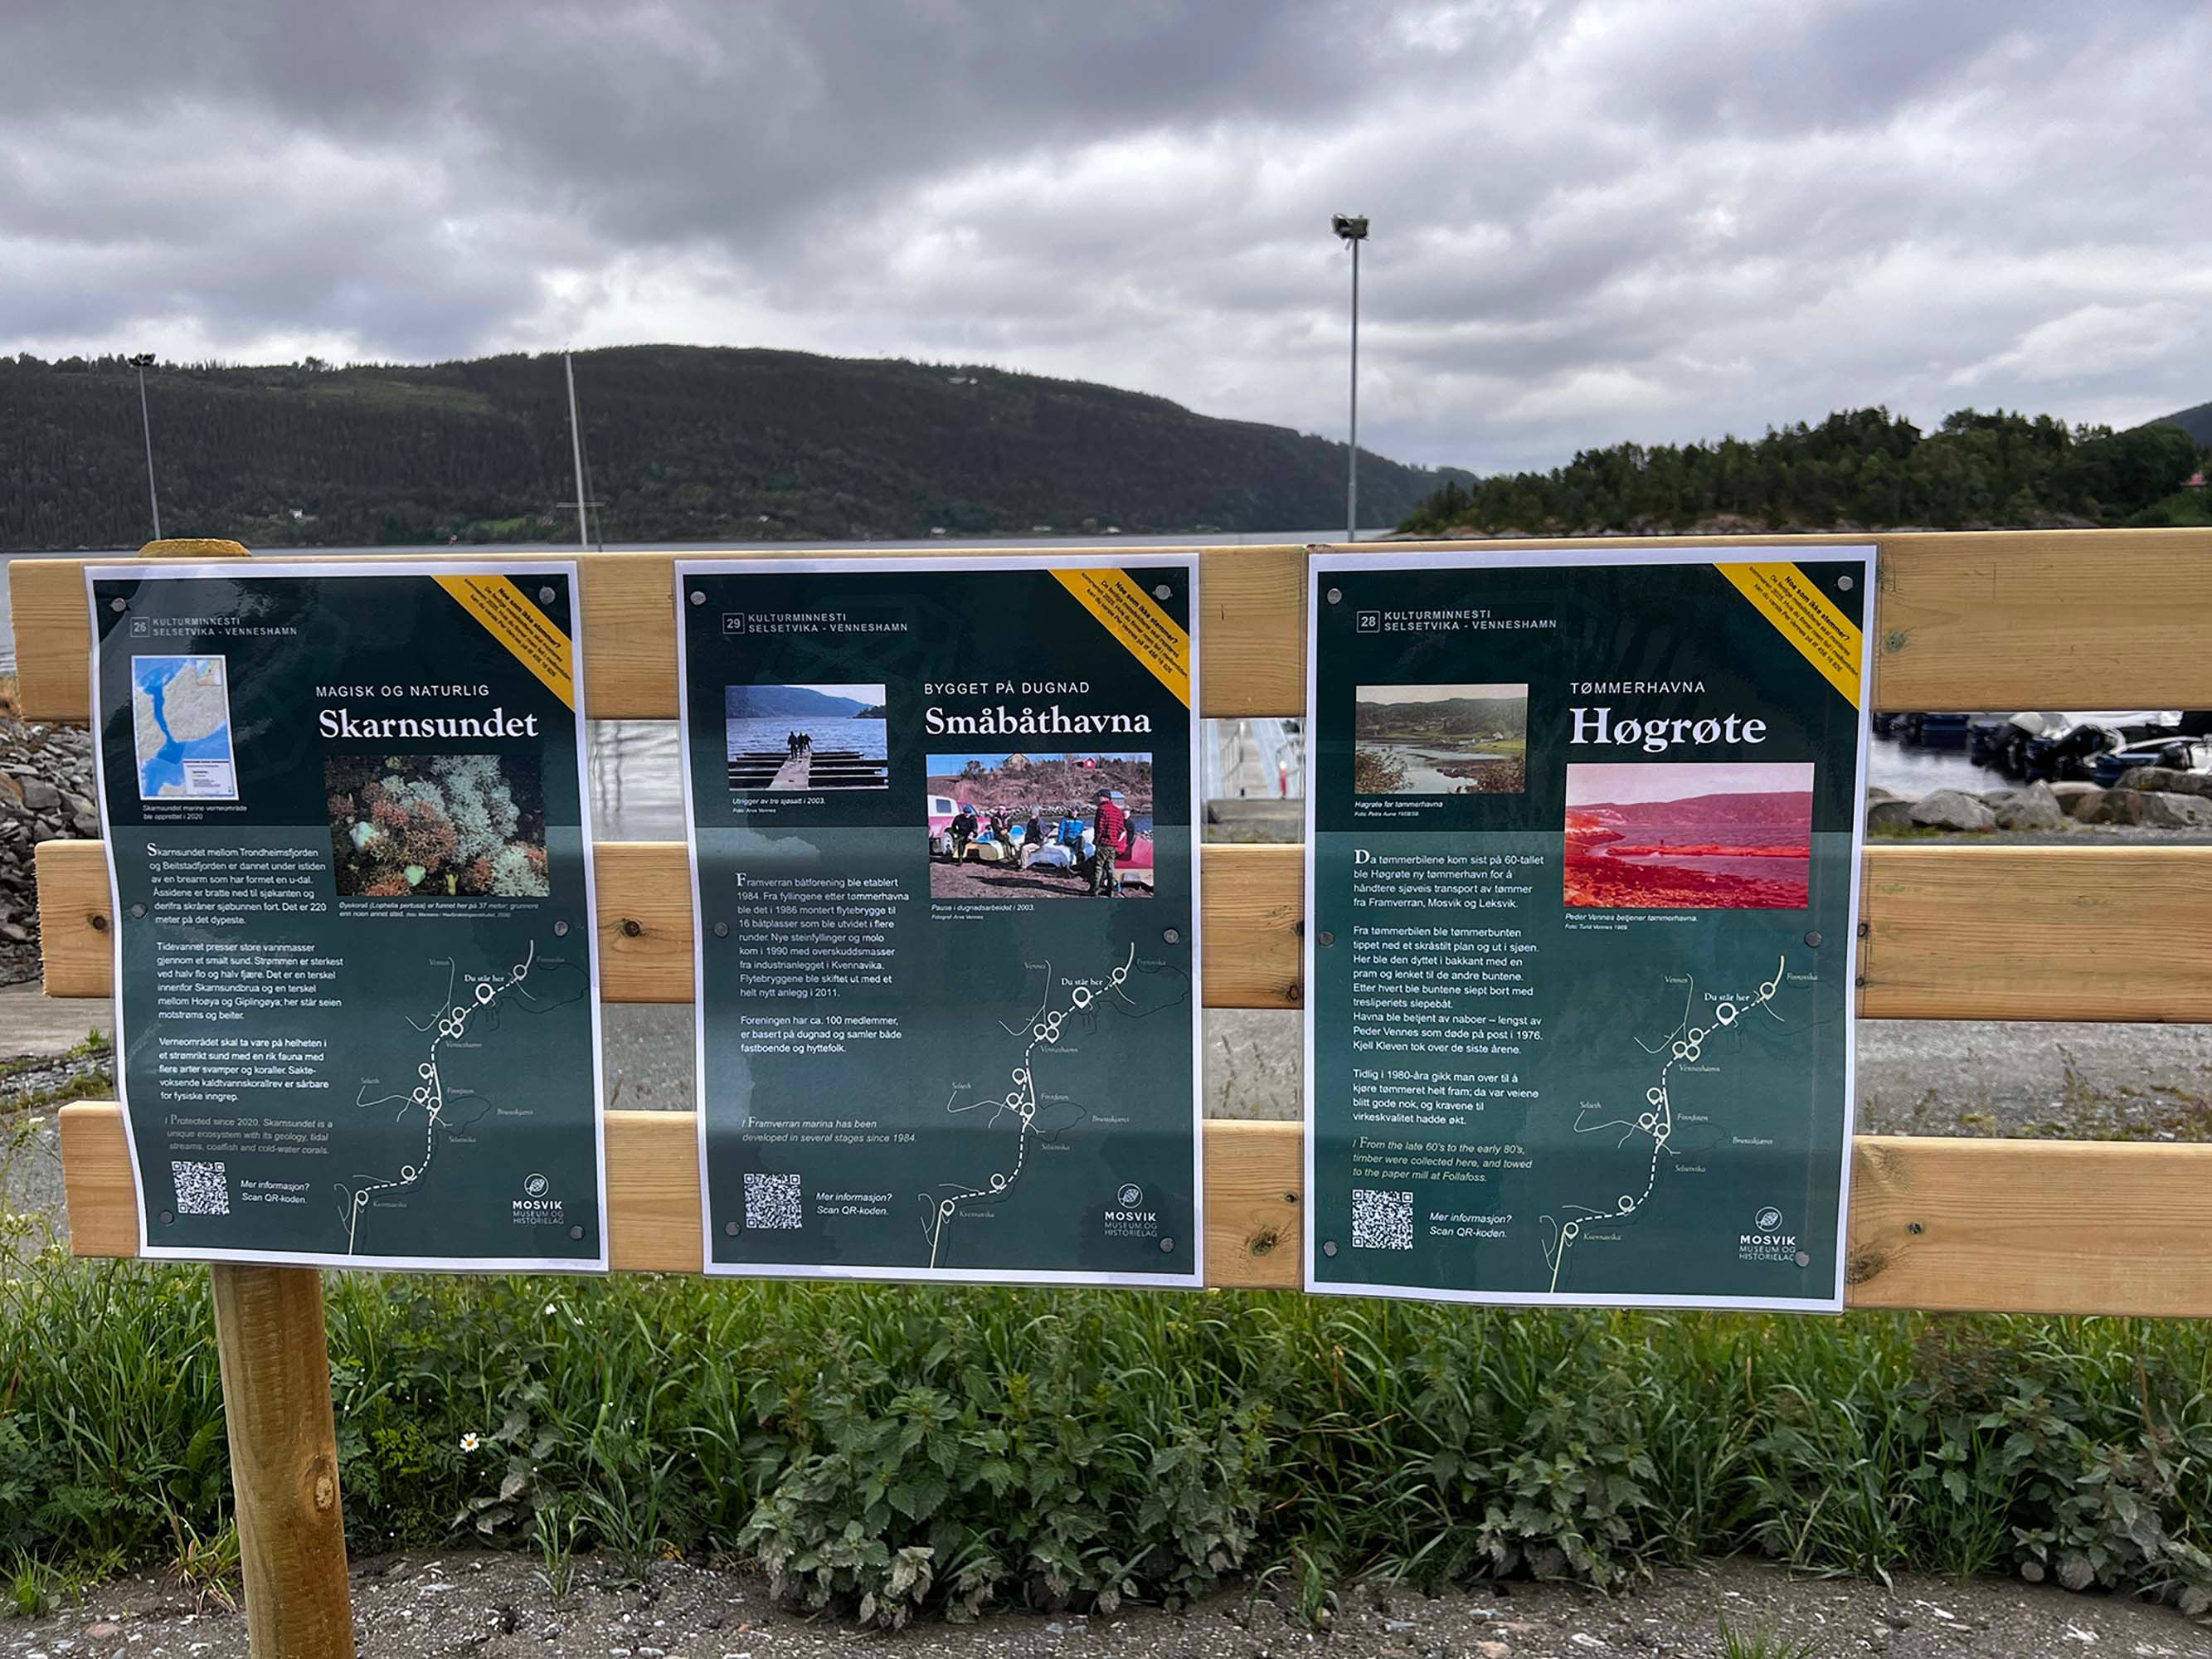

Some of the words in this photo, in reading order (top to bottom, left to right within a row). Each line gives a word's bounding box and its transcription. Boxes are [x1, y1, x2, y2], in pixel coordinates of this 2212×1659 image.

[1115, 581, 1127, 595] Noe
[1127, 593, 1139, 607] som
[1139, 604, 1151, 618] ikke
[1785, 576, 1798, 590] Noe
[1797, 589, 1810, 603] som
[1809, 599, 1822, 614] ikke
[498, 588, 510, 601] Noe
[510, 599, 522, 612] som
[521, 609, 534, 623] ikke
[748, 613, 846, 622] KULTURMINNESTI
[1384, 610, 1490, 620] KULTURMINNESTI
[153, 617, 240, 625] KULTURMINNESTI
[726, 618, 740, 628] 29
[1361, 616, 1375, 626] 28
[1384, 621, 1459, 631] SELSETVIKA
[1472, 619, 1556, 629] VENNESHAMN
[133, 622, 146, 632] 26
[153, 627, 214, 635] SELSETVIKA
[224, 627, 296, 635] VENNESHAMN
[748, 624, 818, 632] SELSETVIKA
[829, 623, 907, 631] VENNESHAMN
[316, 685, 374, 697] MAGISK
[380, 685, 403, 696] OG
[410, 684, 489, 696] NATURLIG
[924, 683, 988, 694] BYGGET
[996, 682, 1014, 693] PÅ
[1022, 681, 1089, 693] DUGNAD
[1570, 681, 1705, 694] TØMMERHAVNA
[319, 707, 538, 737] Skarnsundet
[925, 705, 1151, 734] Småbåthavna
[1569, 707, 1766, 752] Høgrøte
[147, 843, 205, 856] Skarnsundet
[207, 848, 238, 856] mellom
[238, 847, 318, 858] Trondheimsfjorden
[1354, 849, 1376, 864] Da
[1378, 855, 1444, 864] tømmerbilene
[1447, 855, 1467, 864] kom
[1470, 855, 1487, 864] sist
[1489, 855, 1501, 865] på
[1504, 855, 1544, 864] 60-tallet
[149, 862, 160, 871] og
[162, 861, 226, 871] Beitstadfjorden
[270, 862, 295, 870] under
[297, 862, 325, 870] istiden
[245, 875, 274, 883] formet
[288, 875, 312, 883] u-dal.
[1353, 869, 1368, 878] ble
[1370, 869, 1410, 880] Høgrøte
[1413, 871, 1424, 880] ny
[1427, 870, 1487, 878] tømmerhavn
[1490, 869, 1503, 878] for
[1505, 869, 1512, 878] å
[1353, 883, 1395, 892] håndtere
[1398, 884, 1431, 894] sjøveis
[1434, 884, 1477, 894] transport
[1494, 885, 1532, 893] tømmer
[1353, 897, 1366, 906] fra
[1368, 897, 1425, 907] Framverran,
[1427, 898, 1461, 907] Mosvik
[1463, 900, 1476, 909] og
[1478, 898, 1517, 907] Leksvik.
[477, 975, 490, 983] står
[1074, 978, 1088, 987] står
[740, 1016, 790, 1026] Foreningen
[792, 1016, 807, 1024] har
[825, 1016, 842, 1024] 100
[844, 1016, 898, 1025] medlemmer,
[752, 1030, 781, 1038] basert
[783, 1029, 794, 1039] på
[796, 1030, 830, 1040] dugnad
[832, 1031, 844, 1040] og
[846, 1029, 877, 1038] samler
[879, 1030, 902, 1038] både
[740, 1043, 790, 1052] fastboende
[792, 1045, 804, 1054] og
[806, 1043, 845, 1054] hyttefolk.
[1353, 1040, 1373, 1051] Kjell
[1375, 1041, 1408, 1050] Kleven
[1410, 1042, 1425, 1051] tok
[1450, 1043, 1463, 1052] de
[1466, 1043, 1488, 1053] siste
[1491, 1044, 1521, 1054] årene.
[742, 1133, 788, 1143] developed
[800, 1133, 833, 1142] several
[834, 1134, 864, 1143] stages
[893, 1133, 916, 1142] 1984.
[1352, 1167, 1362, 1176] to
[1364, 1168, 1379, 1177] the
[1381, 1170, 1409, 1179] paper
[1430, 1171, 1440, 1180] at
[1442, 1171, 1486, 1181] Follafoss.
[240, 1179, 256, 1188] Mer
[258, 1181, 310, 1192] informasjon?
[241, 1192, 262, 1201] Scan
[264, 1193, 307, 1203] QR-koden.
[815, 1192, 834, 1200] Mer
[835, 1192, 892, 1203] informasjon?
[512, 1200, 562, 1209] MOSVIK
[816, 1205, 839, 1214] Scan
[841, 1205, 888, 1214] QR-koden.
[1105, 1211, 1155, 1221] MOSVIK
[1429, 1212, 1449, 1221] Mer
[1450, 1213, 1512, 1225] informasjon?
[1429, 1226, 1453, 1235] Scan
[1456, 1227, 1506, 1237] QR-koden.
[1740, 1235, 1795, 1245] MOSVIK
